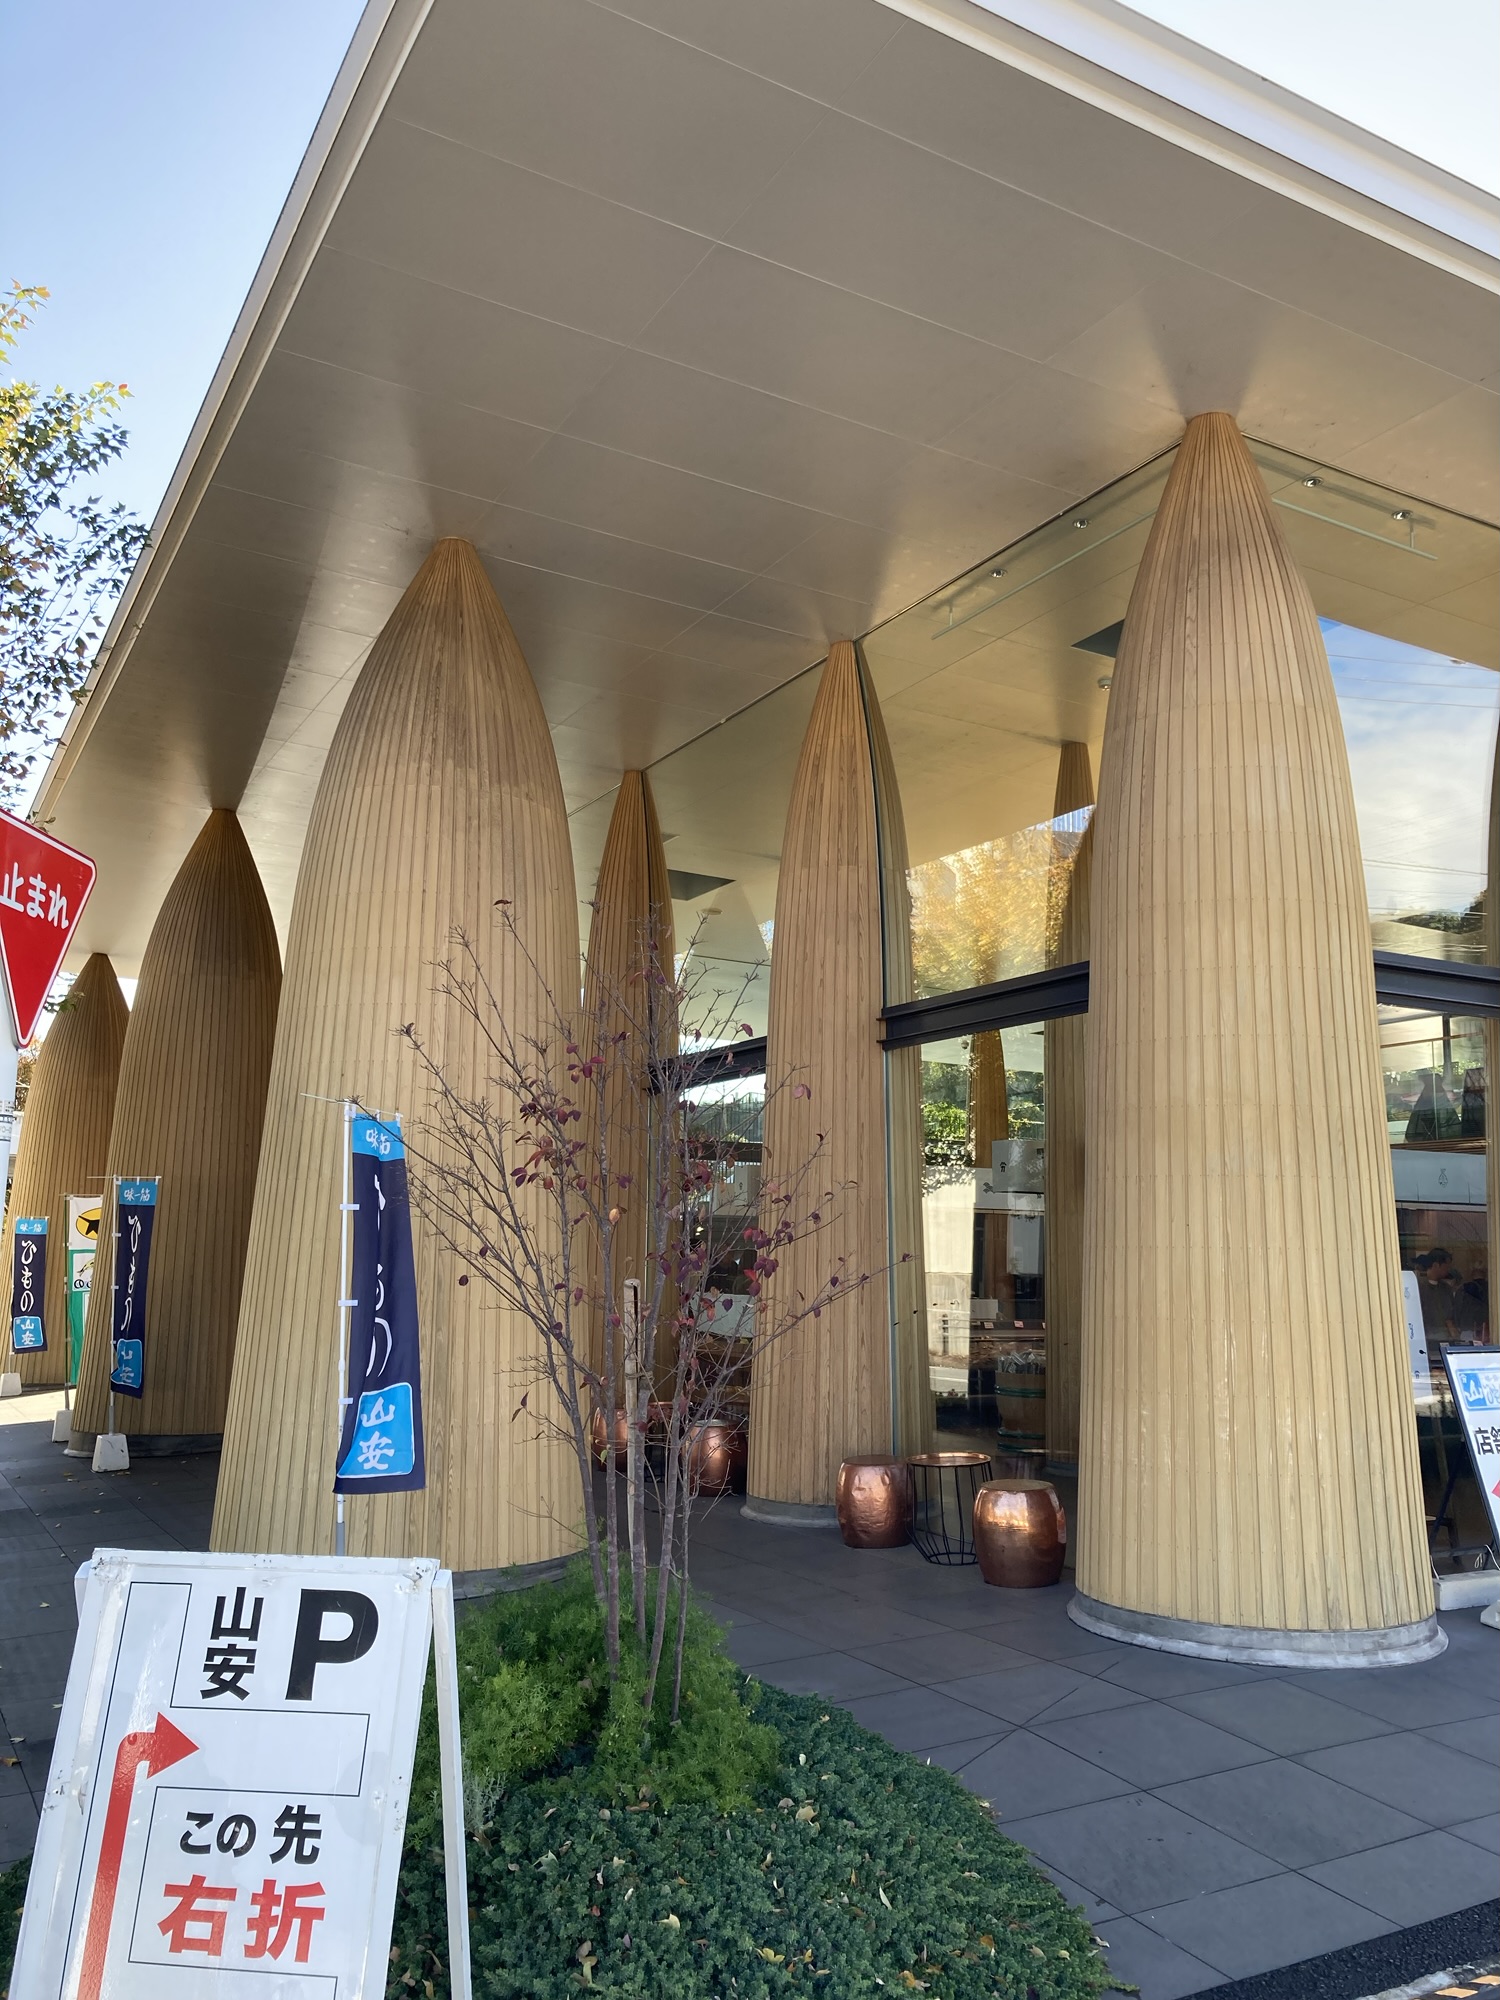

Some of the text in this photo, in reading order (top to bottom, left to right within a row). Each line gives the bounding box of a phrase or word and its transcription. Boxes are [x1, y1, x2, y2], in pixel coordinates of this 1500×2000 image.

[0, 861, 70, 930] 止まれ
[20, 1239, 38, 1312] ひもの
[20, 1319, 36, 1346] 山安
[356, 1396, 396, 1471] 山安
[200, 1586, 379, 1702] 山安 P
[179, 1804, 323, 1865] この先
[157, 1875, 327, 1964] 右折
